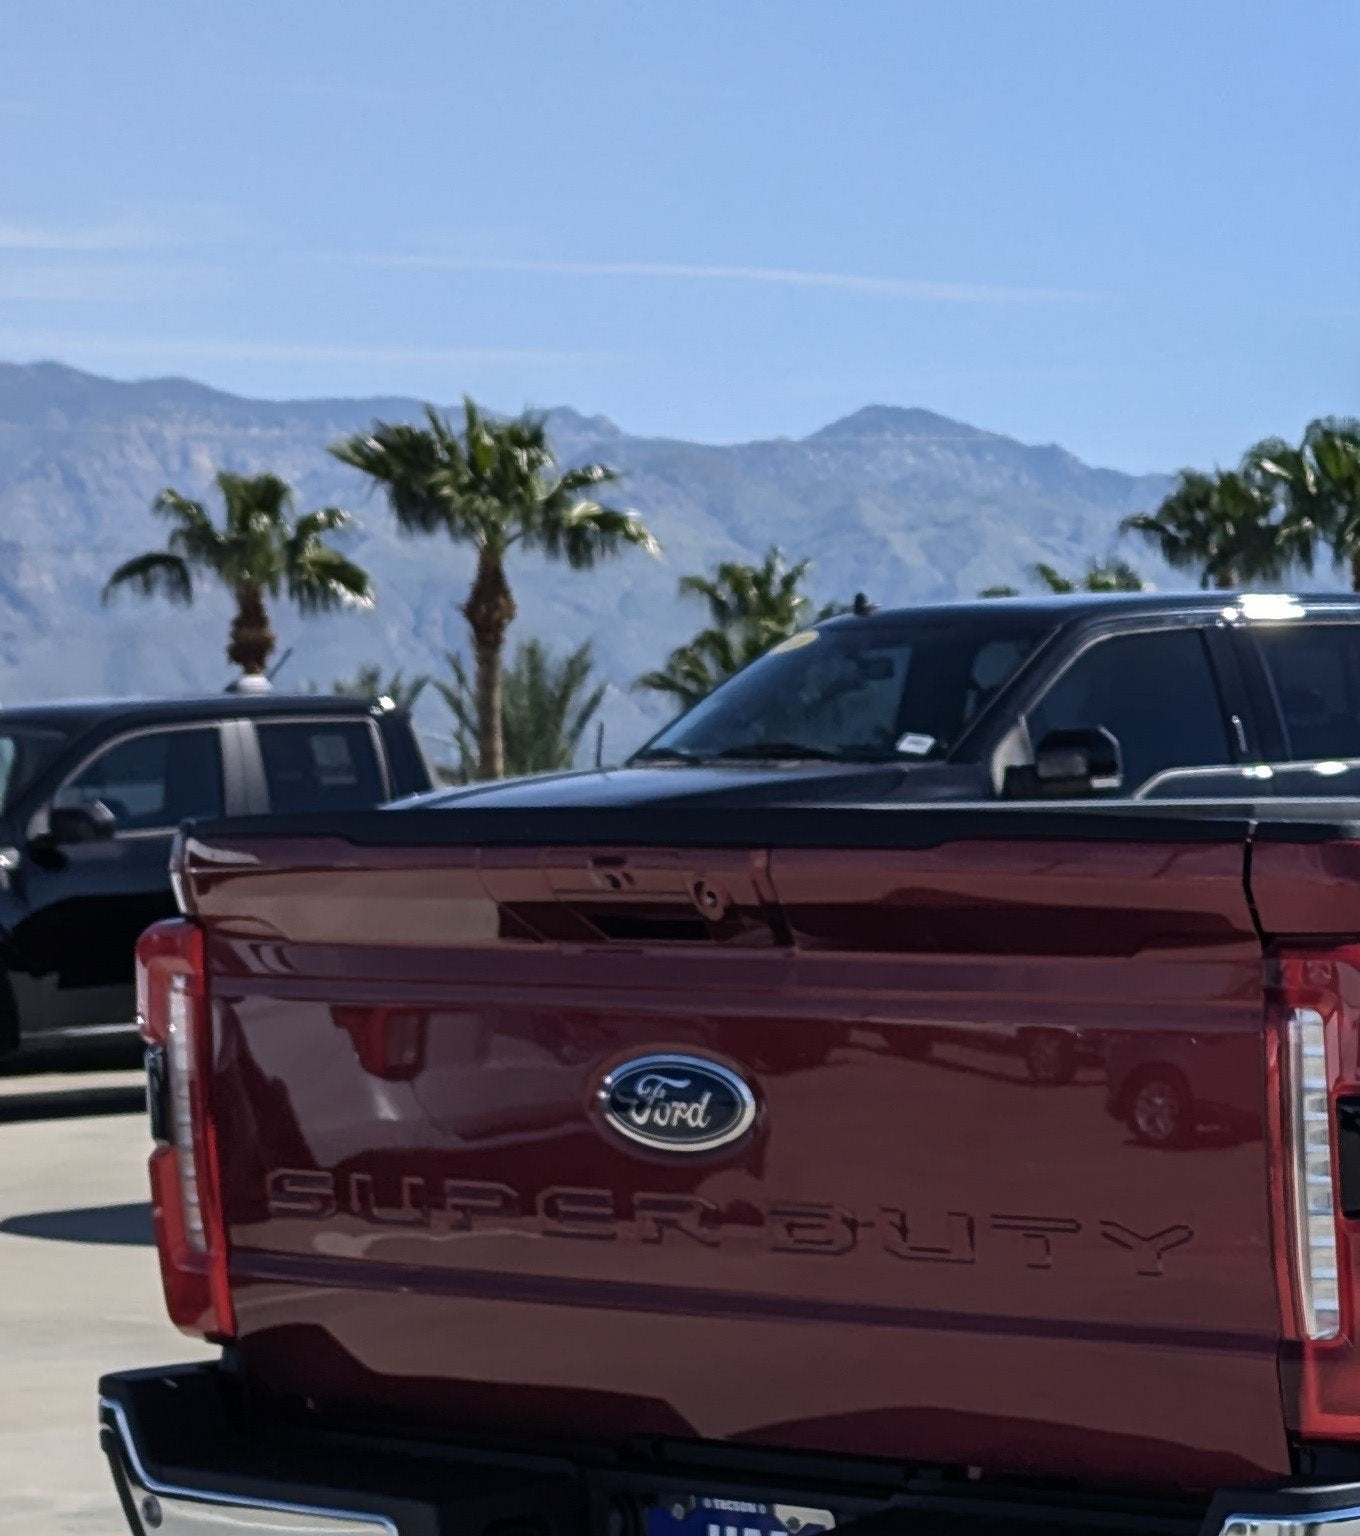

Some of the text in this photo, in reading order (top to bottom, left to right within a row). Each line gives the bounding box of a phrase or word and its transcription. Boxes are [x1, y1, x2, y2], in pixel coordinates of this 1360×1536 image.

[616, 1073, 713, 1129] Ford
[266, 1168, 1195, 1277] SUPER DUTY
